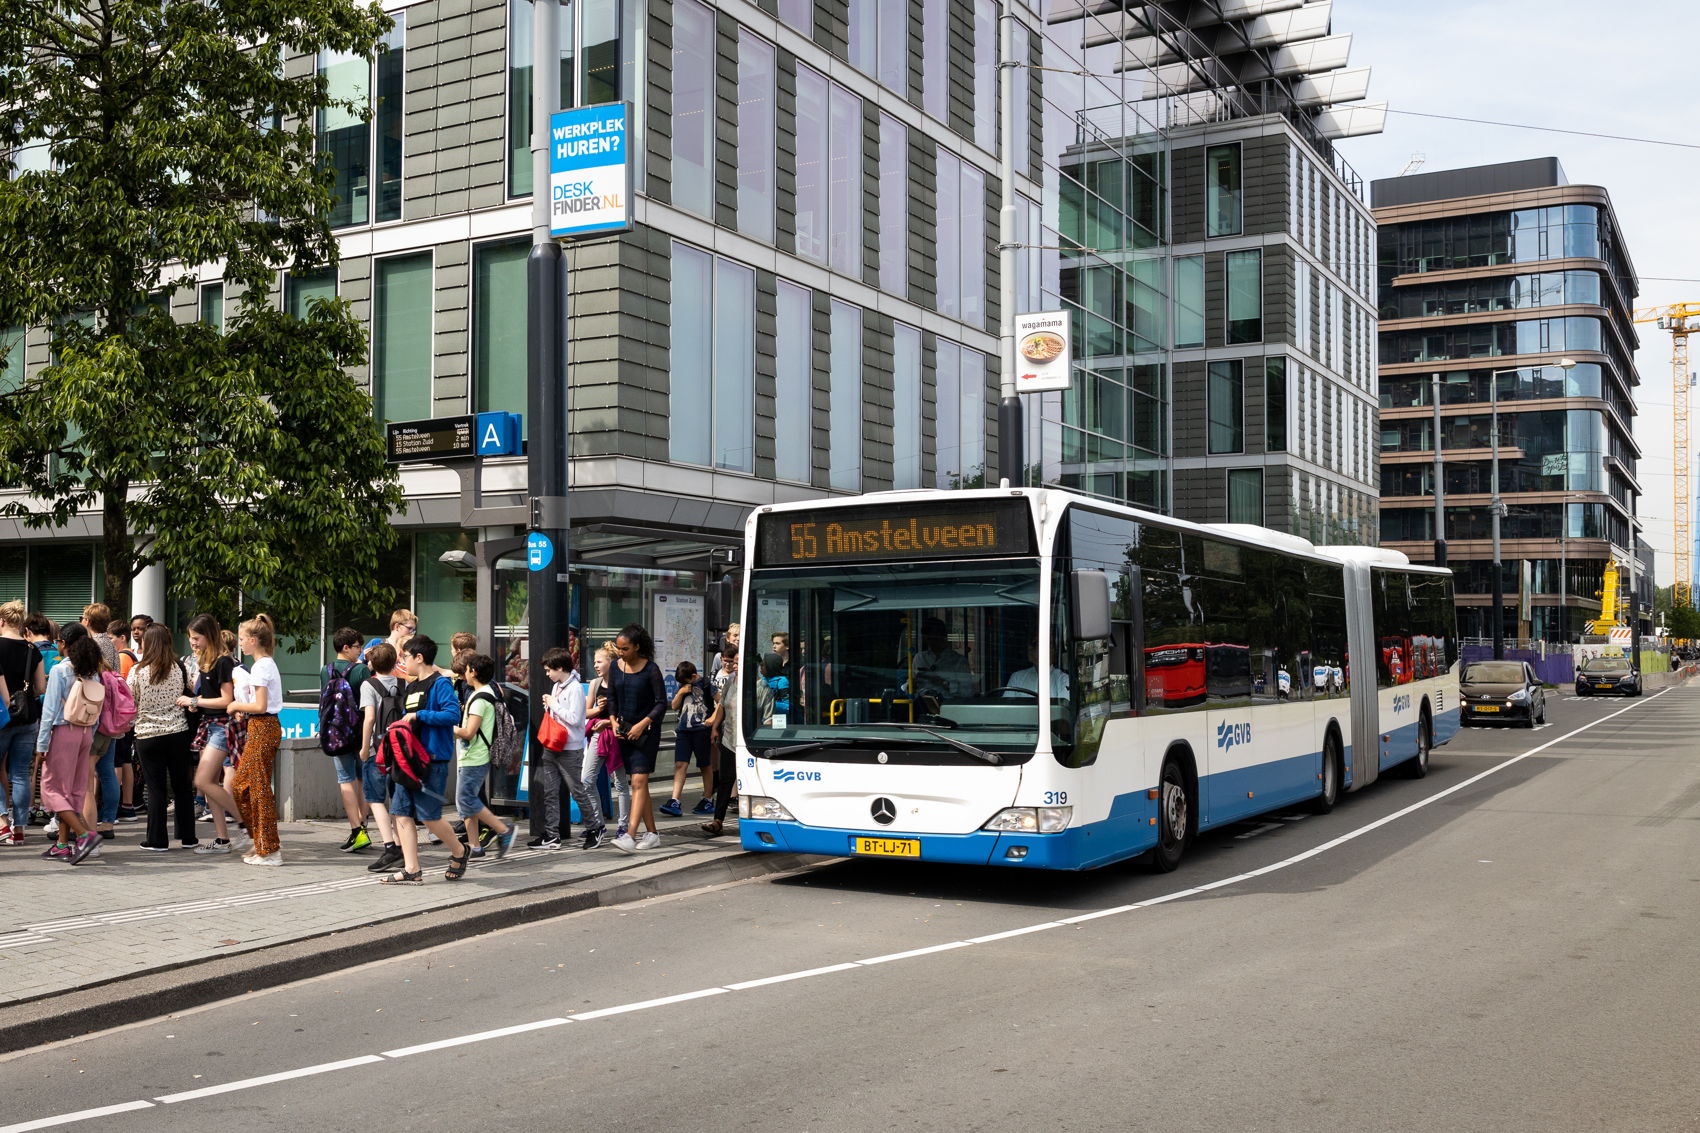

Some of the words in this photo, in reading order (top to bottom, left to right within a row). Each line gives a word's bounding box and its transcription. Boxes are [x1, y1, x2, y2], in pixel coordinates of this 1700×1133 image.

[553, 118, 624, 140] WERKPLEK
[557, 136, 620, 159] HUREN?
[553, 181, 593, 201] DESK
[1022, 320, 1063, 329] wagamama
[402, 433, 431, 441] Amstelveen
[481, 423, 501, 448] A
[402, 446, 431, 454] Amstelveen
[538, 540, 547, 548] 55
[790, 522, 817, 559] 55
[826, 518, 994, 553] Amstelveen
[1234, 722, 1251, 746] GVB
[796, 771, 821, 781] GVB
[1043, 791, 1068, 805] 319
[864, 840, 911, 854] BT-LJ-71
